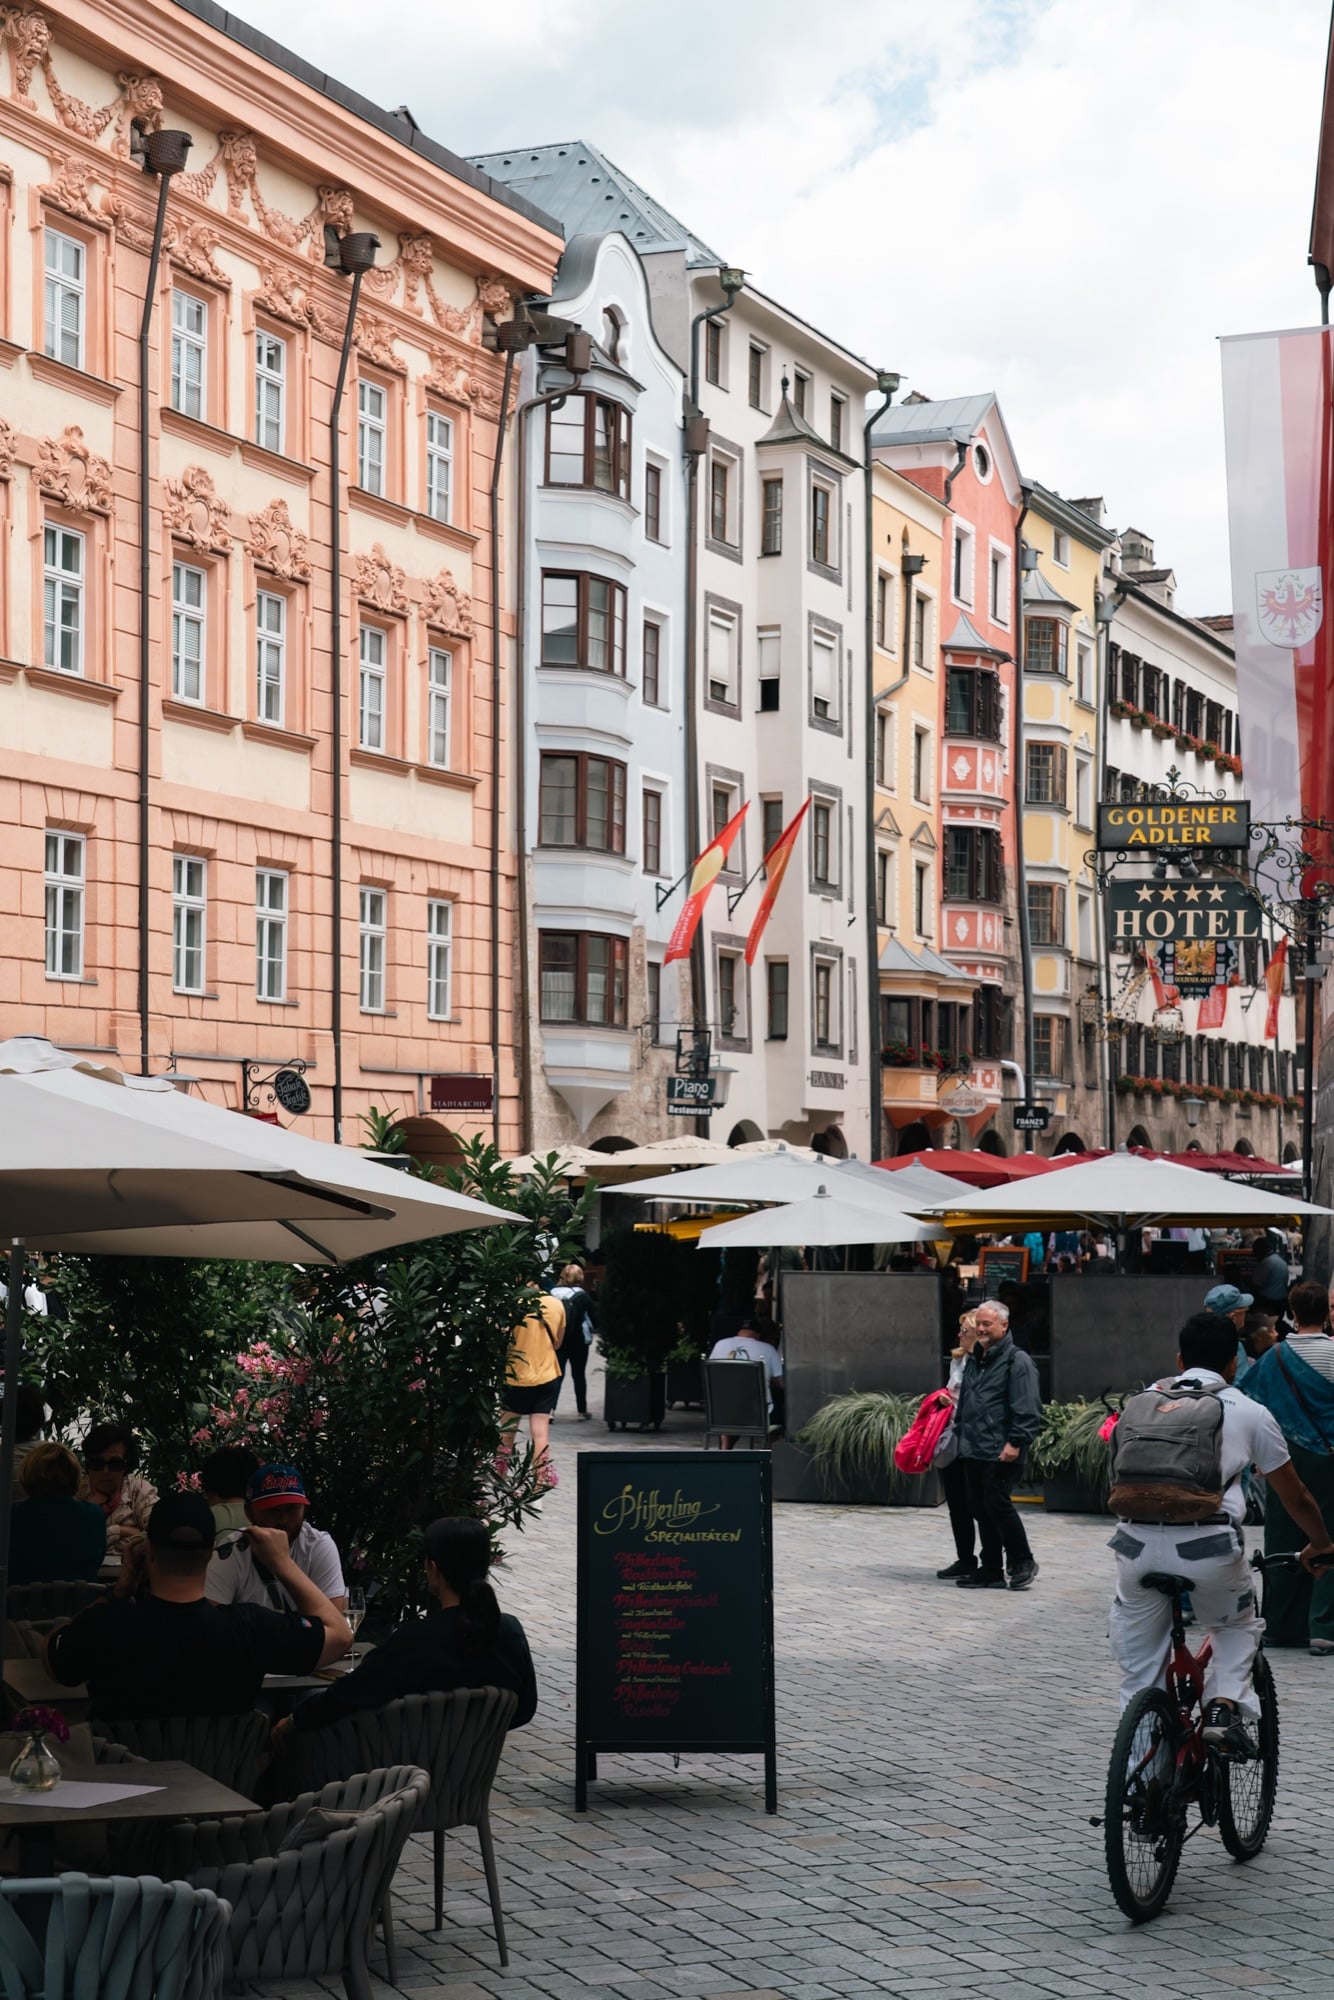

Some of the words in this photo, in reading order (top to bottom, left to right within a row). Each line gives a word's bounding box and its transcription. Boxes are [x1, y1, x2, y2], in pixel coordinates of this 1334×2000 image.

[1107, 806, 1238, 826] GOLDENER
[1127, 826, 1212, 845] ADLER
[1113, 909, 1260, 938] HOTEL
[275, 1075, 305, 1097] Tabak
[674, 1078, 710, 1098] Piano
[812, 1071, 844, 1088] BANK
[282, 1088, 310, 1111] Trafik
[433, 1100, 488, 1108] STADTARCHIV
[668, 1104, 711, 1115] Restaurant
[594, 1484, 720, 1535] Pfifferling
